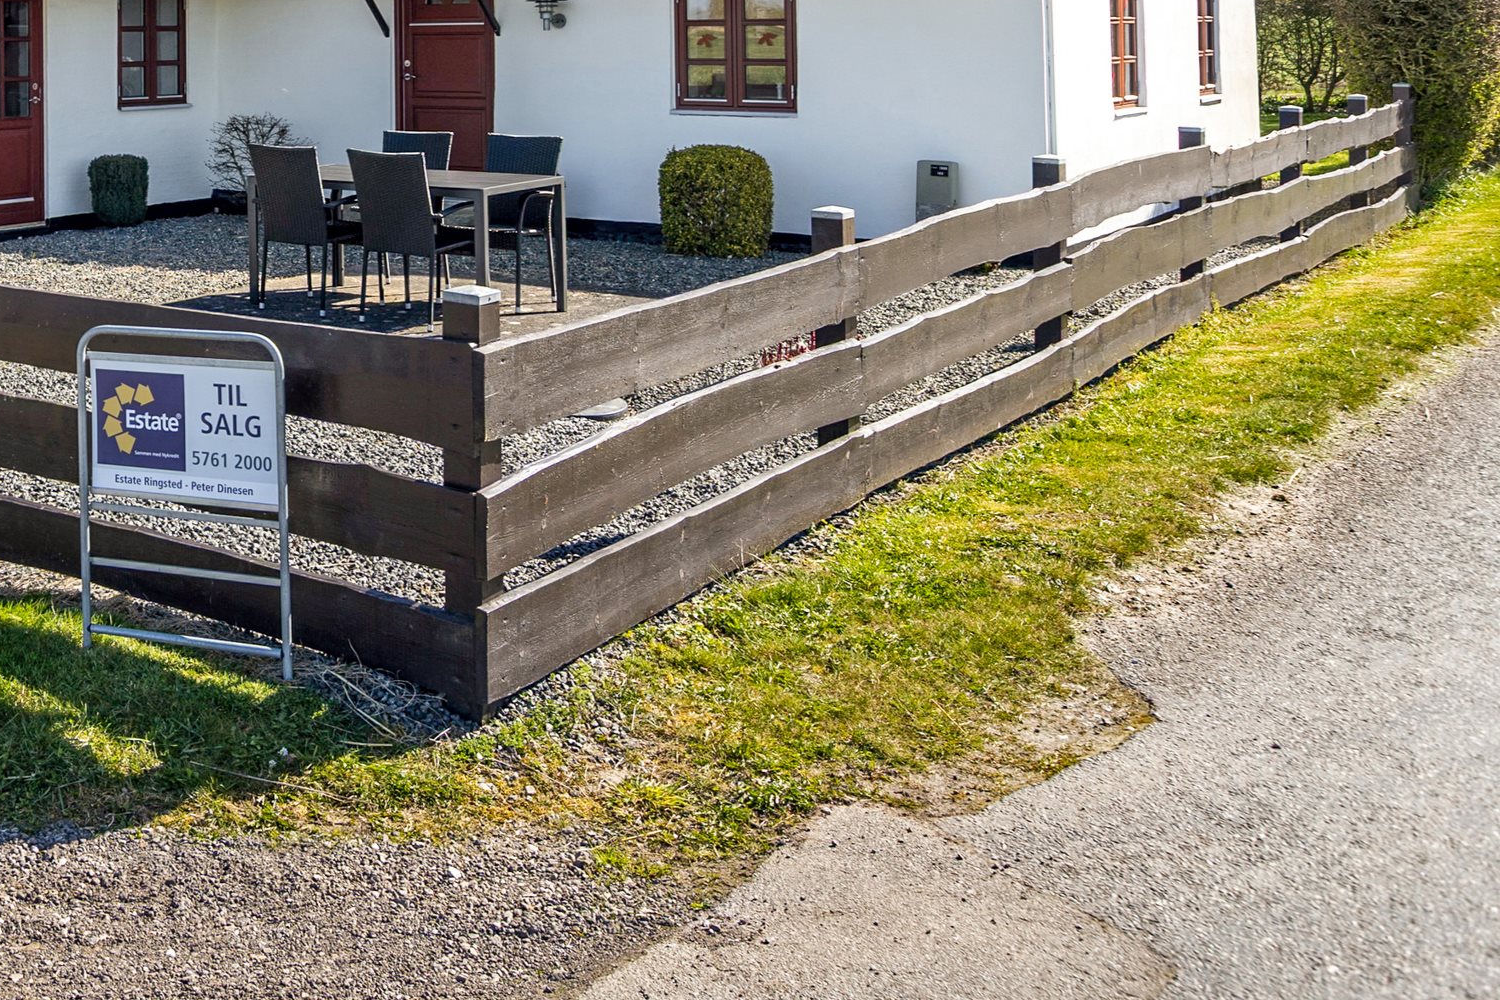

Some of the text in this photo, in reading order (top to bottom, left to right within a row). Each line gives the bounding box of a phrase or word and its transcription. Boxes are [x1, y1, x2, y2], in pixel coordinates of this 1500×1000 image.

[213, 383, 247, 407] TIL
[125, 409, 179, 432] Estate
[200, 412, 261, 438] SALG
[192, 450, 272, 472] 5761 2000
[115, 474, 141, 485] Estate
[144, 476, 183, 489] Ringsted
[191, 481, 215, 492] Peter
[217, 484, 254, 496] Dinesen
